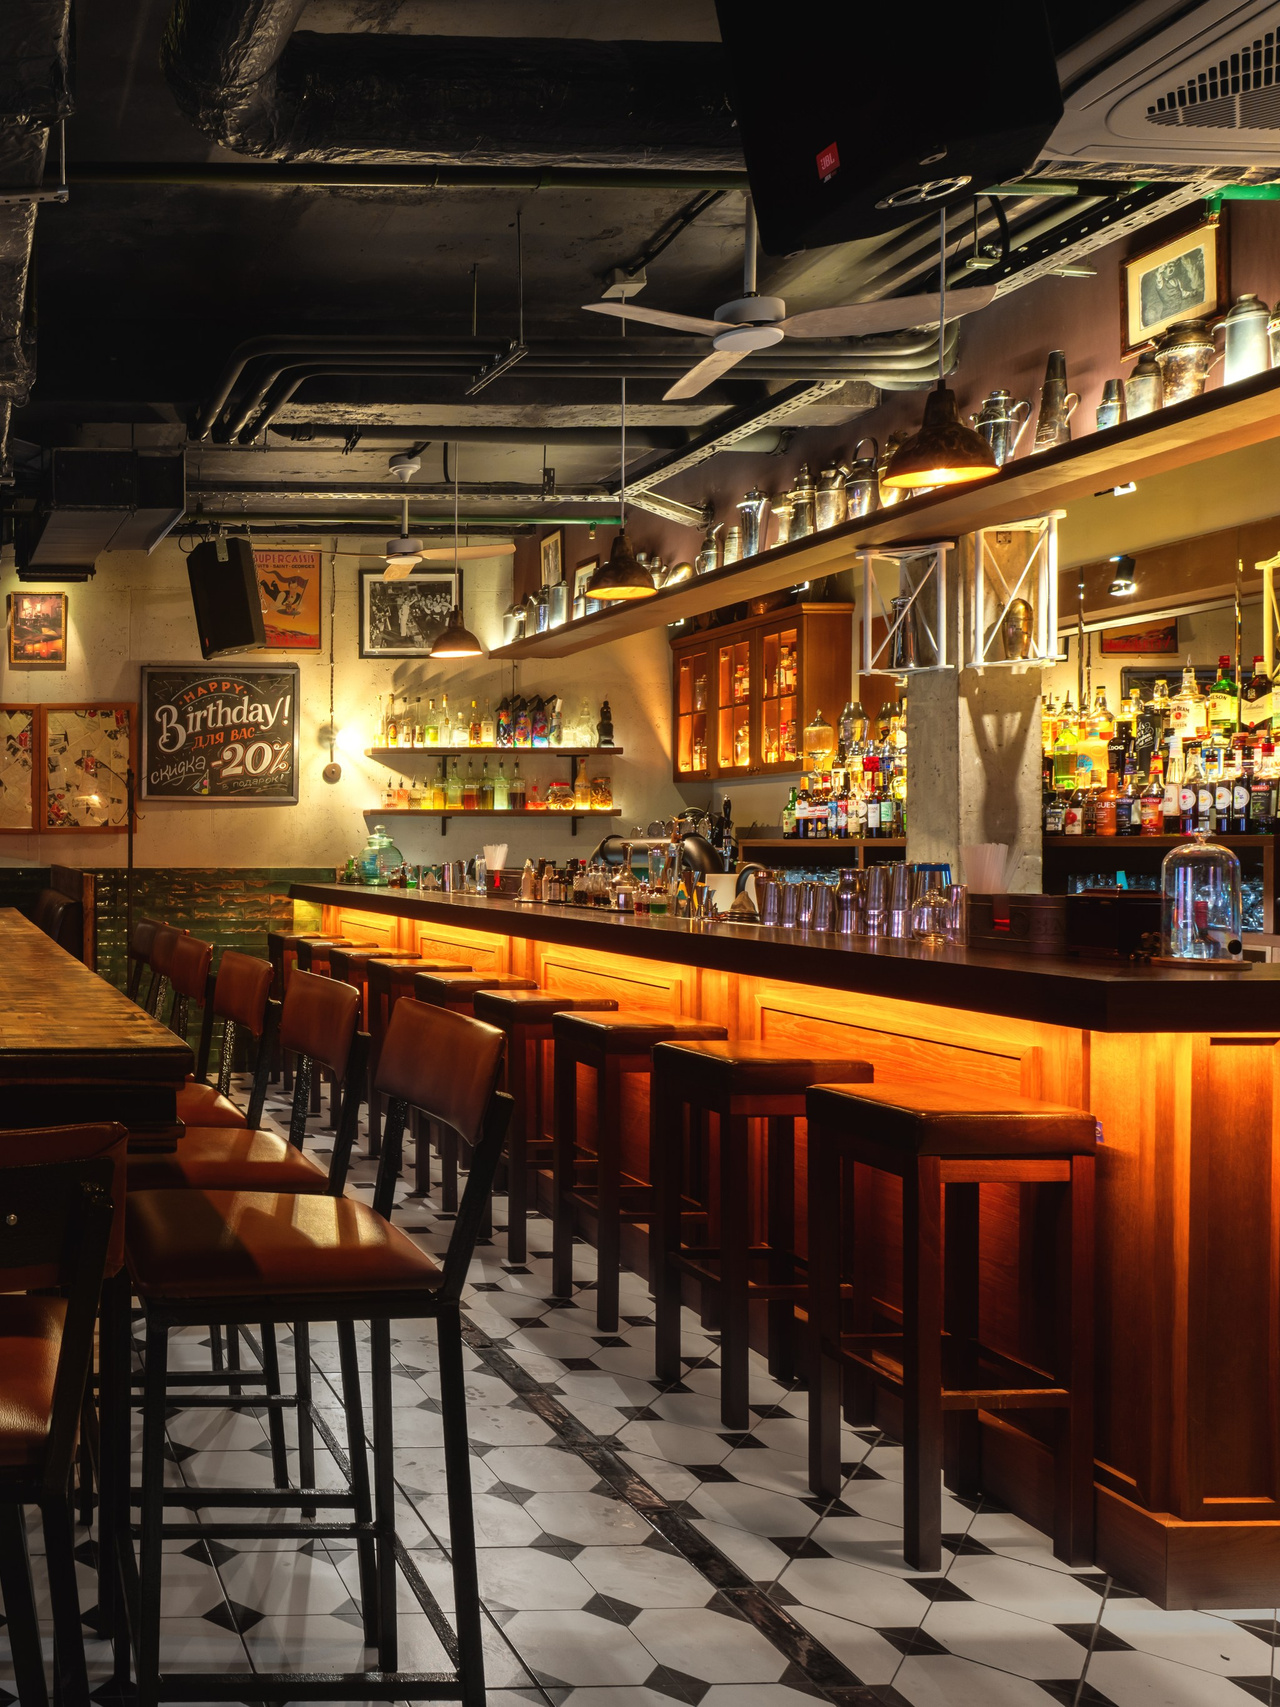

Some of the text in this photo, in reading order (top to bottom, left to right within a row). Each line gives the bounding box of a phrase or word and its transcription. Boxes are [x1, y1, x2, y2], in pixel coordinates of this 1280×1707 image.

[820, 153, 835, 170] JBL
[183, 682, 243, 703] HAPPY
[154, 694, 292, 753] Birthday!
[191, 726, 256, 751] ДЛЯ ВАС
[211, 741, 292, 779] -20%
